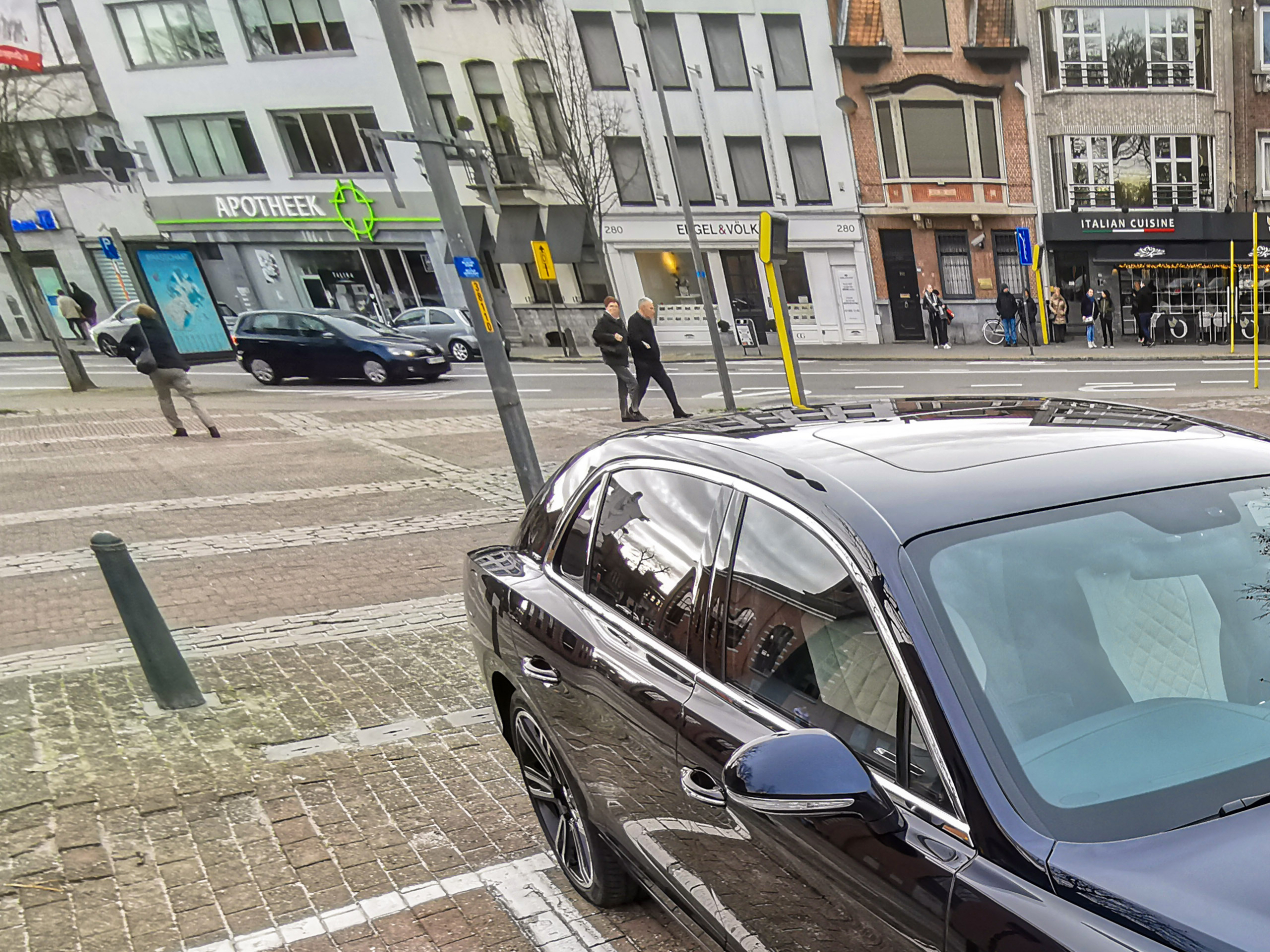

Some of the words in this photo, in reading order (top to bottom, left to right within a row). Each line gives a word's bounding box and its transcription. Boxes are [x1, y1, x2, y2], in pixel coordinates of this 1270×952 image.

[215, 195, 326, 217] APOTHEEK
[836, 224, 855, 233] 280
[1081, 218, 1125, 229] ITALIAN
[1130, 218, 1175, 228] CUISINE
[604, 225, 623, 235] 280
[473, 282, 492, 332] 38110
